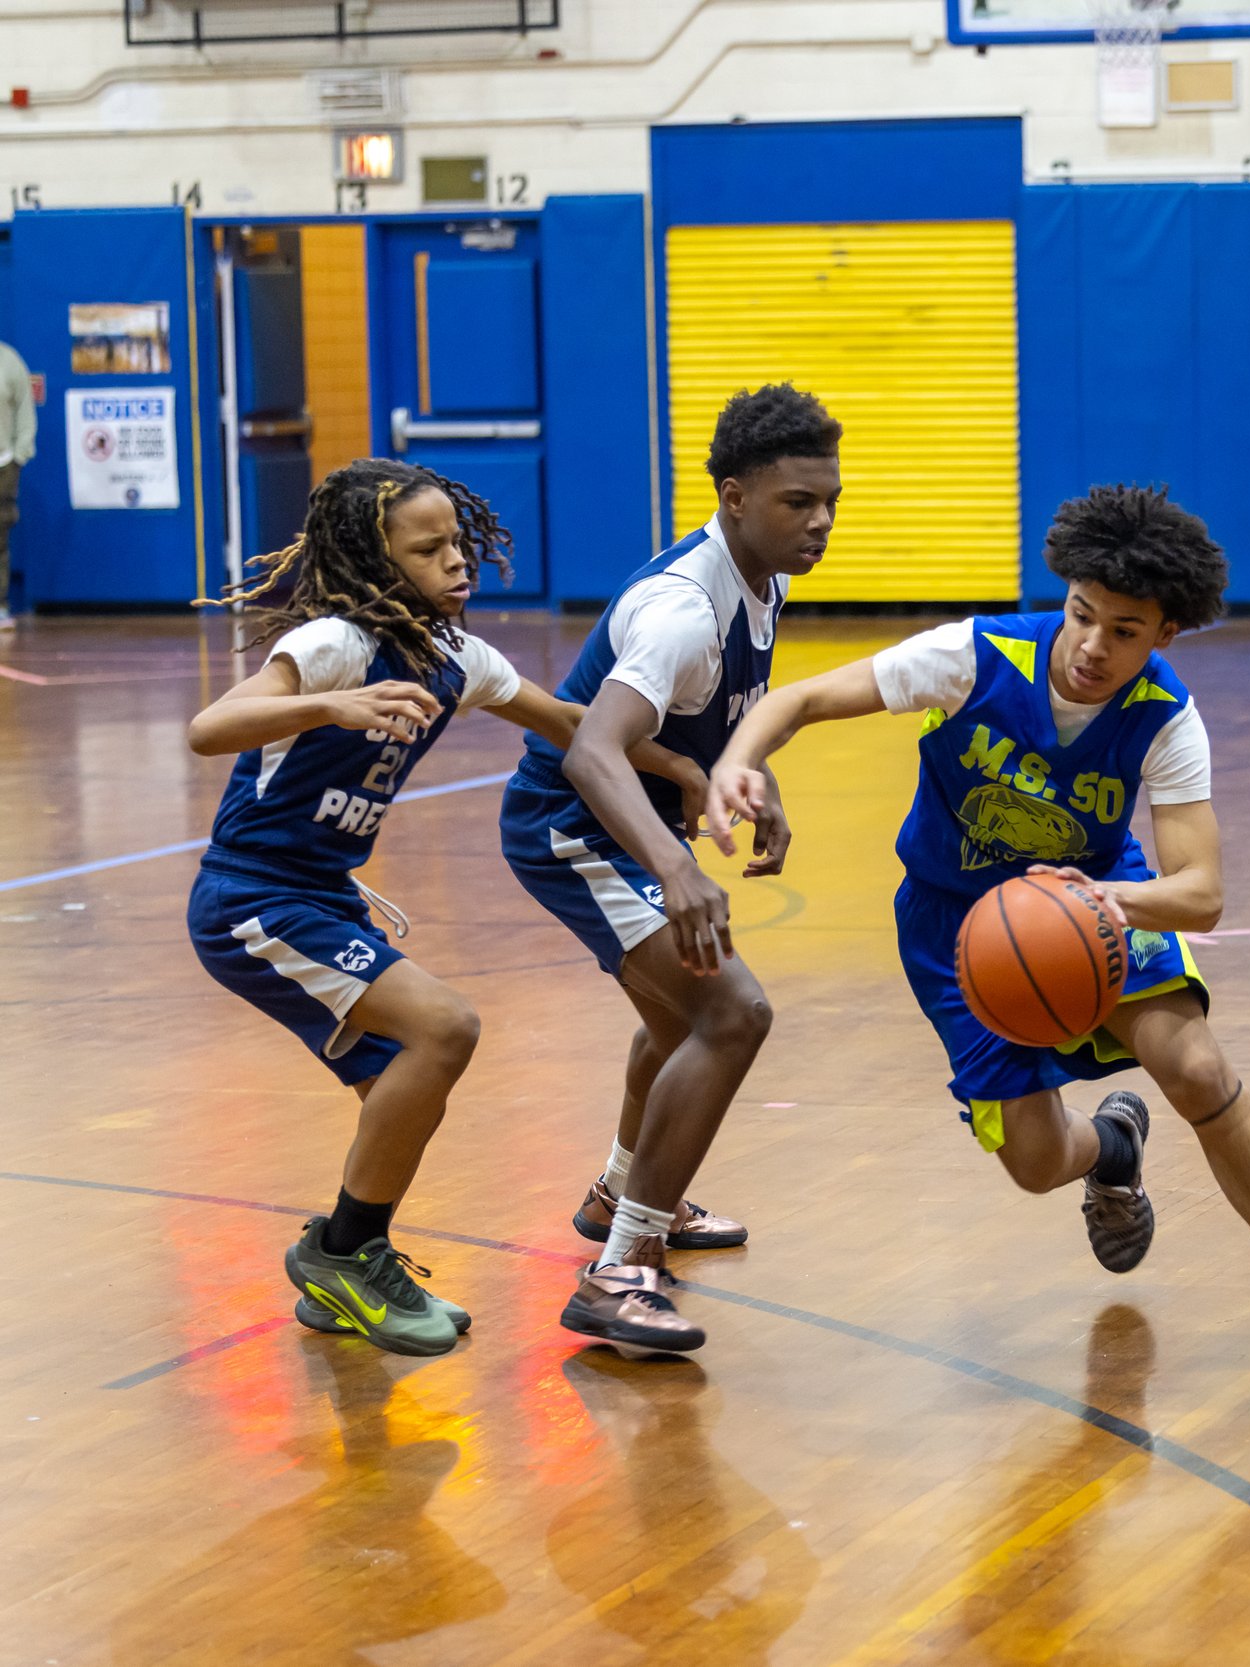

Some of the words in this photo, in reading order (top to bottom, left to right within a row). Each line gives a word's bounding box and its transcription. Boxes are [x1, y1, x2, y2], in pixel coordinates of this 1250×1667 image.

[11, 185, 43, 212] 15
[172, 181, 203, 209] 14
[335, 181, 368, 213] 13
[496, 174, 529, 204] 12
[83, 399, 164, 419] NOTICE
[959, 723, 1057, 800] M.S.
[1068, 772, 1125, 824] 50
